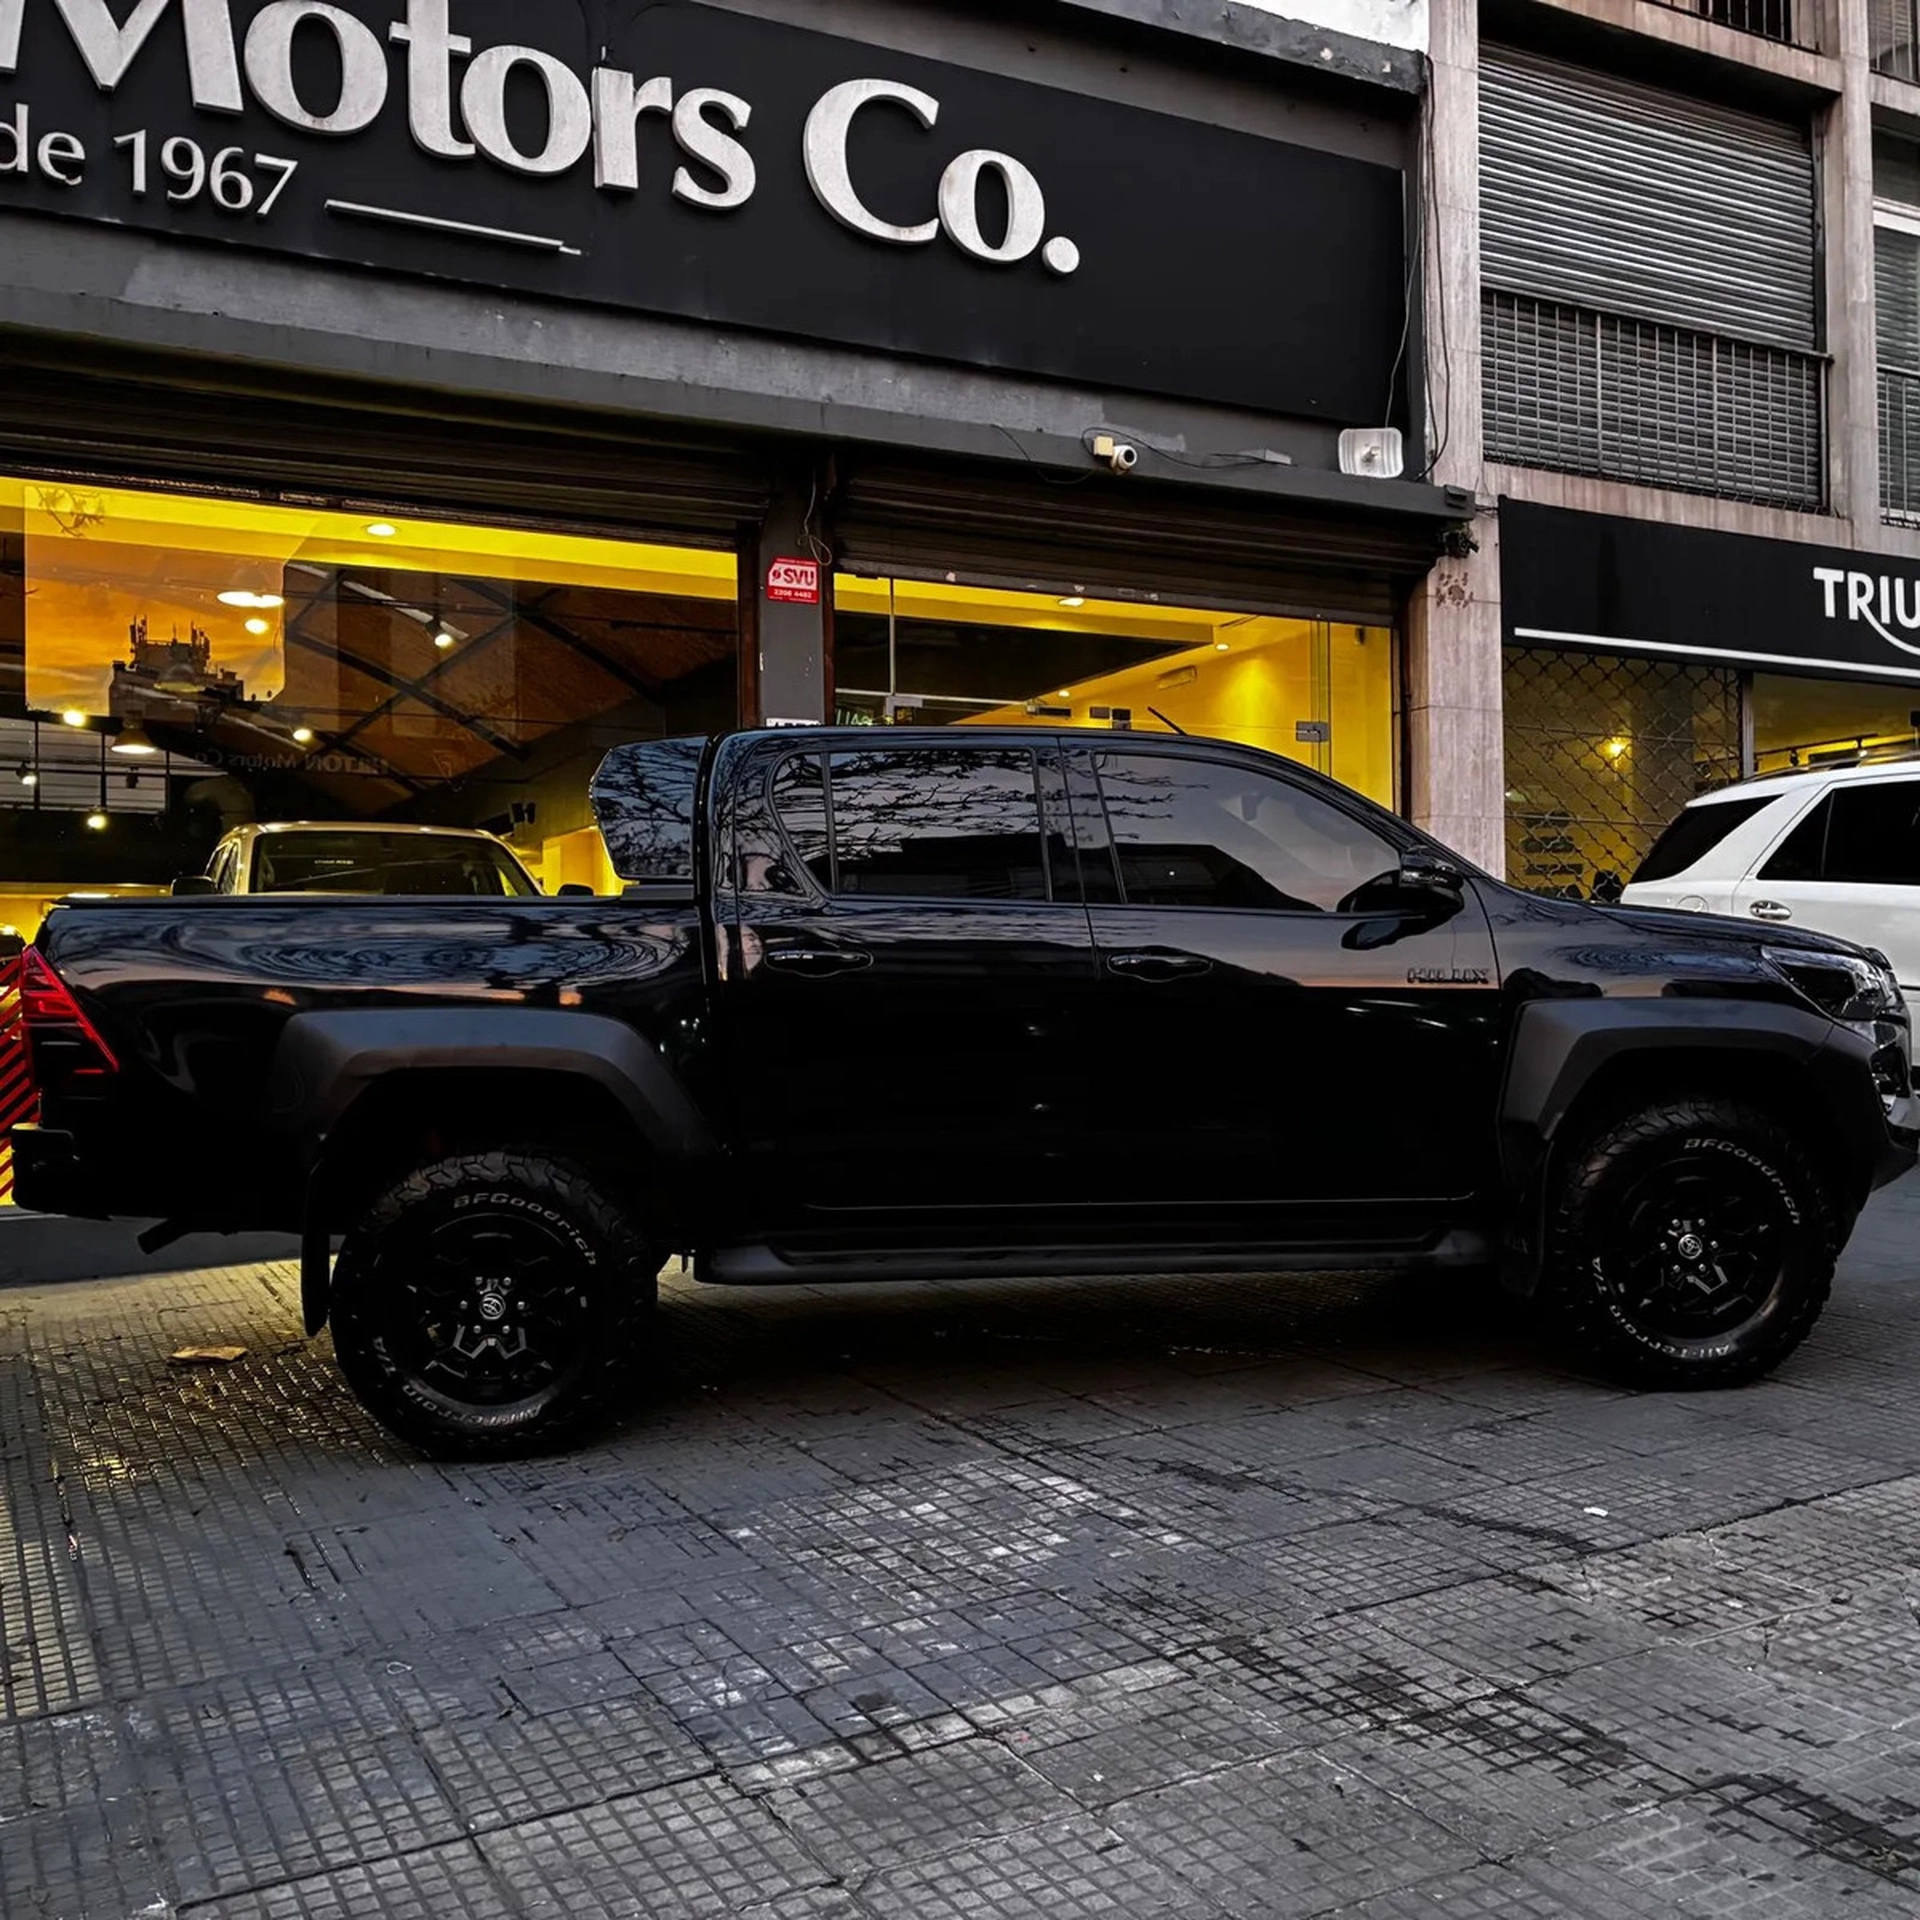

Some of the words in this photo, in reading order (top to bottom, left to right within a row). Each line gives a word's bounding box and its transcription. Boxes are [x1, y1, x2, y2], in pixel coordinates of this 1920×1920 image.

[0, 0, 756, 211] Motors
[802, 77, 1081, 276] Co.
[113, 129, 299, 217] 1967
[783, 568, 814, 586] SVU
[1813, 566, 1920, 656] TRIU
[1684, 1137, 1800, 1225] BFGoodrich
[453, 1192, 596, 1265] BFGoodrich
